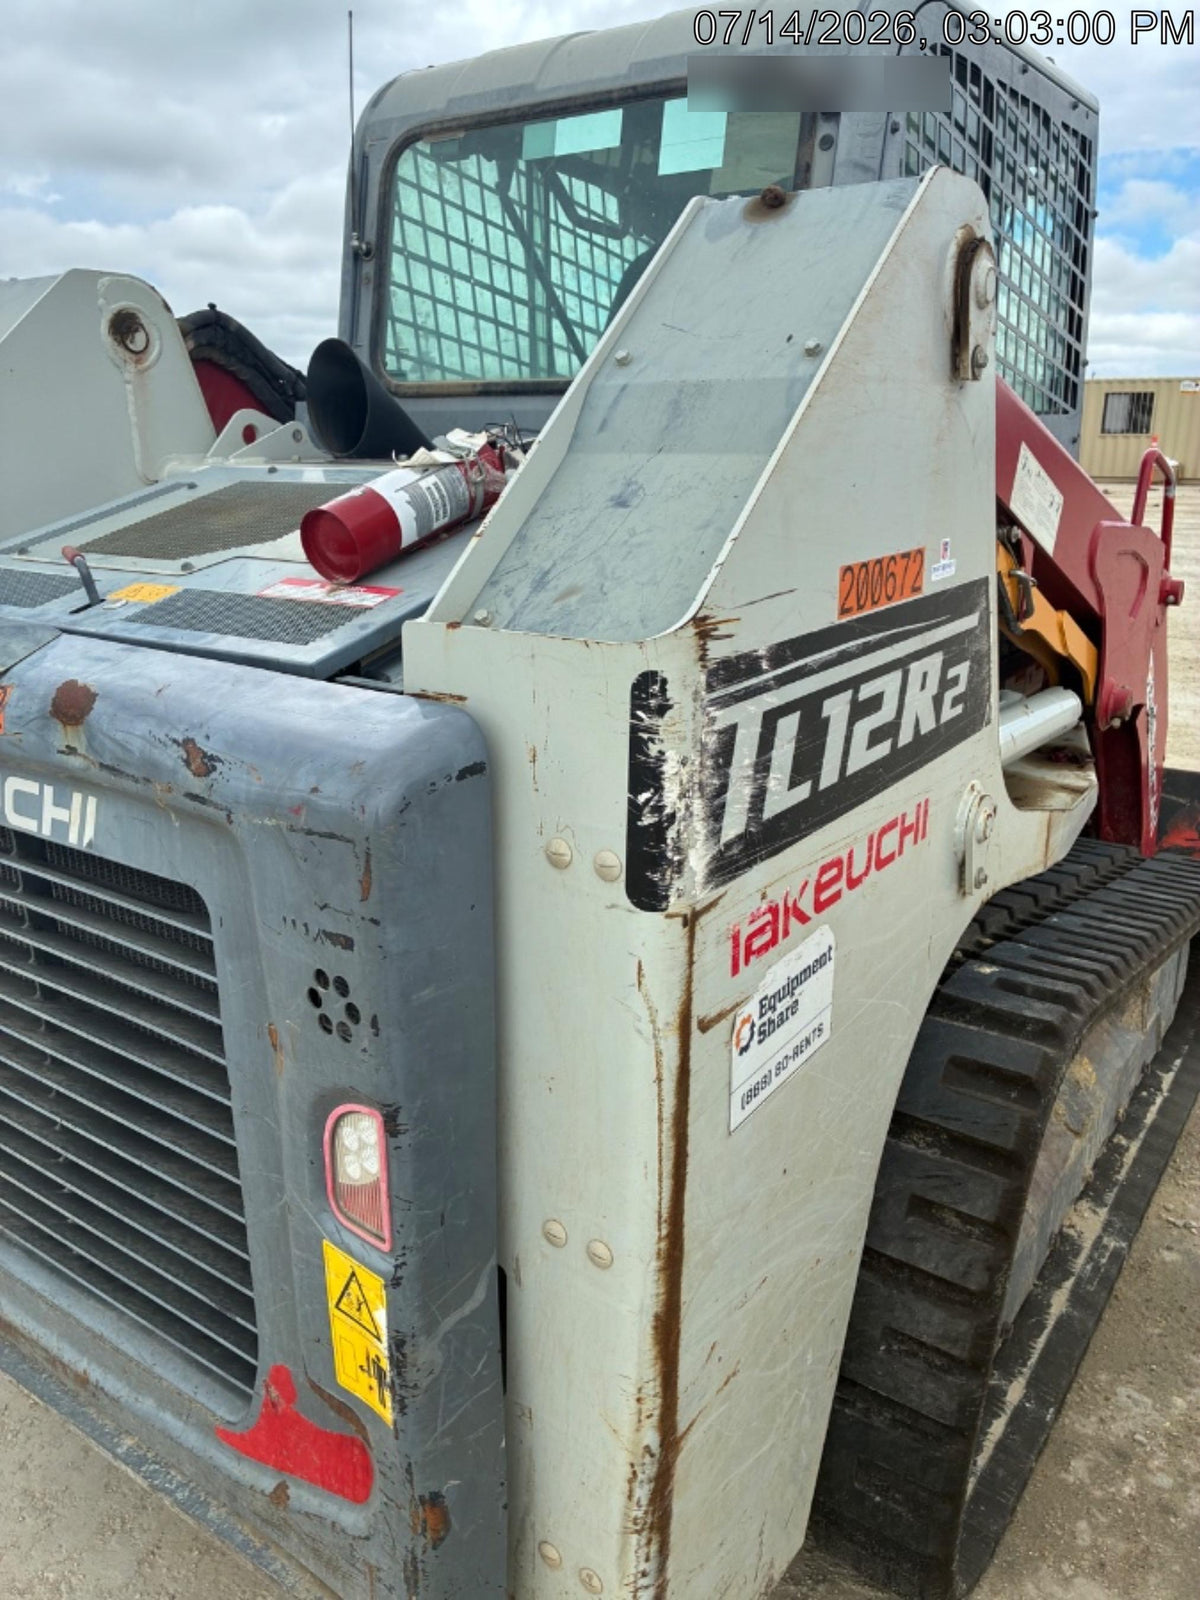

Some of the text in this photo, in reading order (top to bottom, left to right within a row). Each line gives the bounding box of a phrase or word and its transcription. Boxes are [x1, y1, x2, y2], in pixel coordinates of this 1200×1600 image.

[838, 548, 924, 615] 200672
[758, 944, 833, 1020] Equipment
[757, 998, 800, 1046] Share
